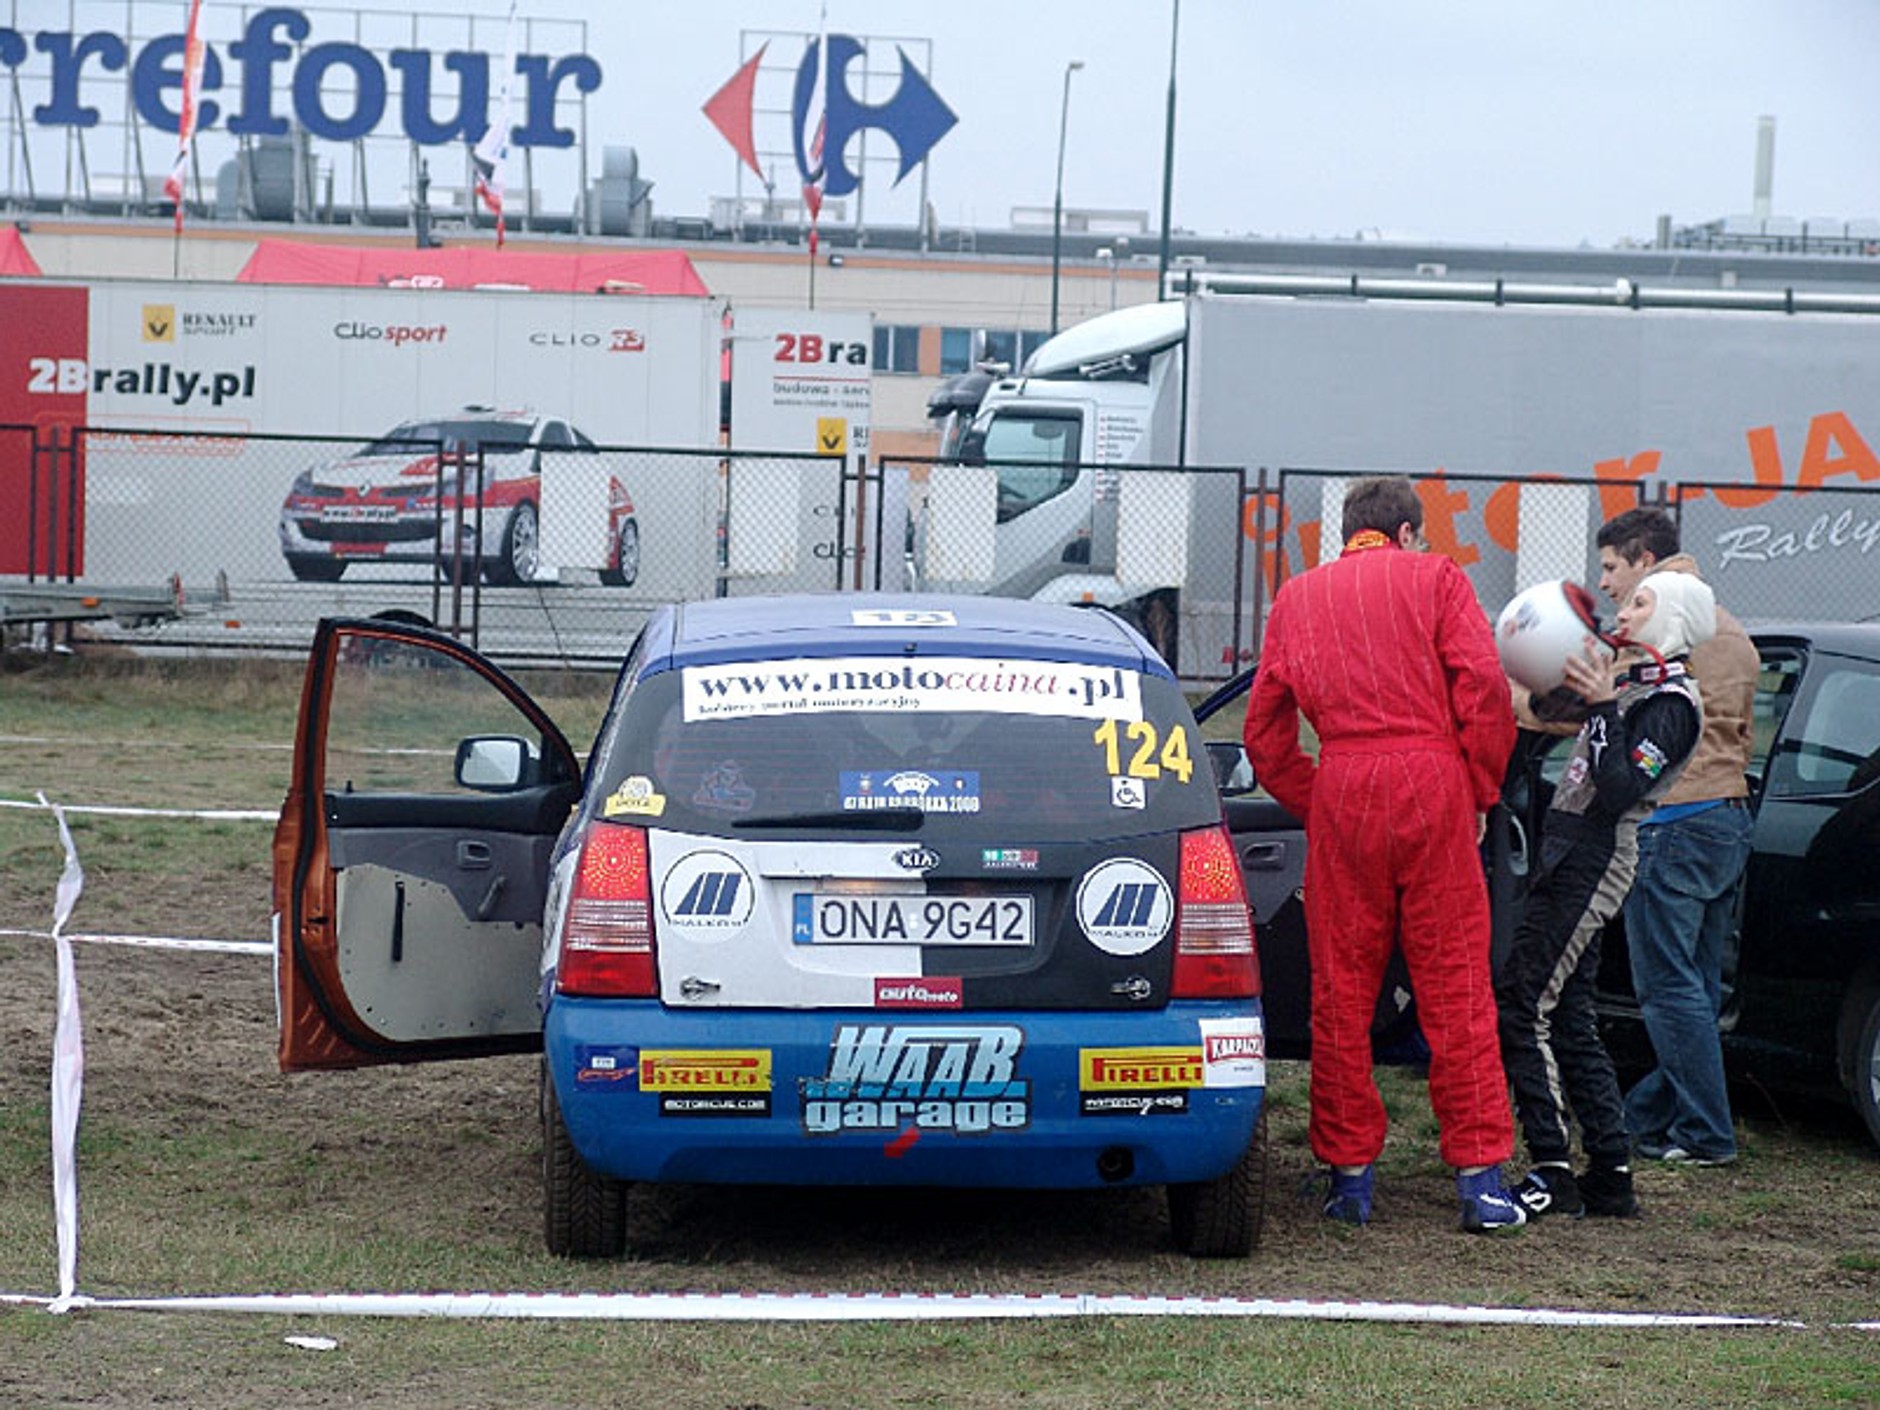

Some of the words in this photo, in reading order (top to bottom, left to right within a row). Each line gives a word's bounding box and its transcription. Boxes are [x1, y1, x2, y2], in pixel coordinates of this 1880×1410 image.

[0, 6, 602, 148] refour
[529, 333, 601, 347] CLIO
[27, 357, 256, 406] 2Brally.pl
[1717, 509, 1880, 570] Rally
[700, 662, 1125, 706] www.motocaina.pl
[1094, 718, 1193, 783] 124
[901, 849, 933, 866] KIA
[820, 900, 908, 938] ONA
[923, 901, 1024, 941] 9G42
[1091, 1056, 1203, 1083] PIRELLI
[806, 1101, 1026, 1132] garage
